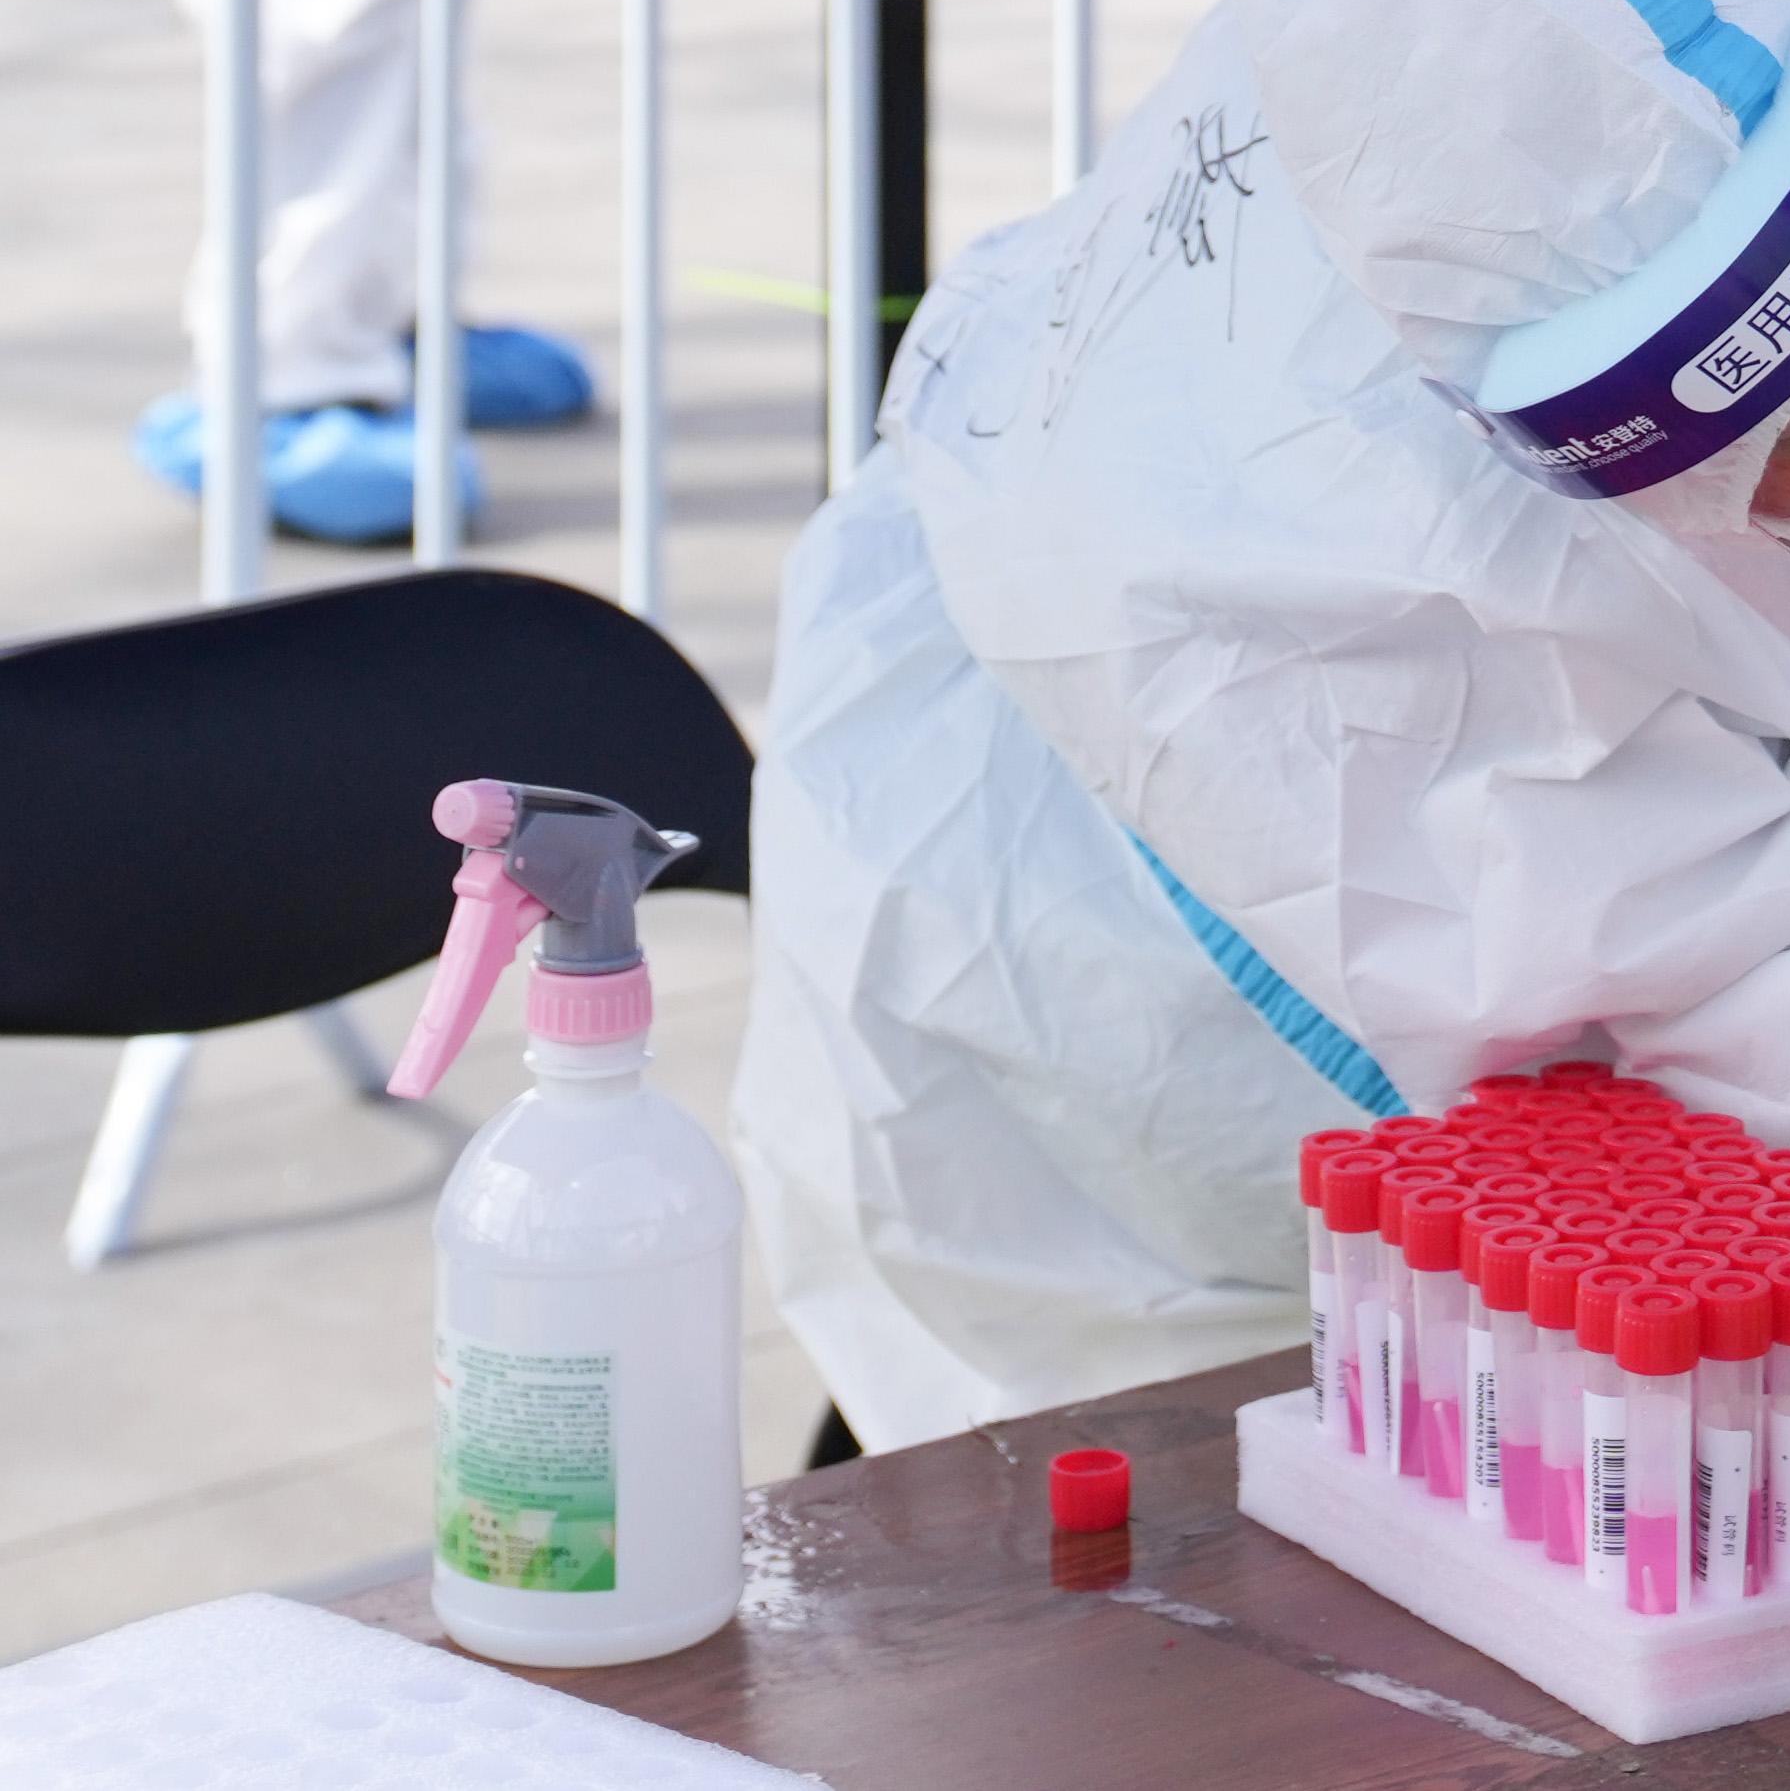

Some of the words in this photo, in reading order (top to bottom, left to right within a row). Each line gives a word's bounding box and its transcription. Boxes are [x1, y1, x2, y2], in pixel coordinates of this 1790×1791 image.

[1591, 415, 1657, 451] 安登特
[1629, 429, 1669, 454] quality
[1475, 1371, 1484, 1486] 50000855154207
[1591, 1437, 1600, 1552] 50000855239823
